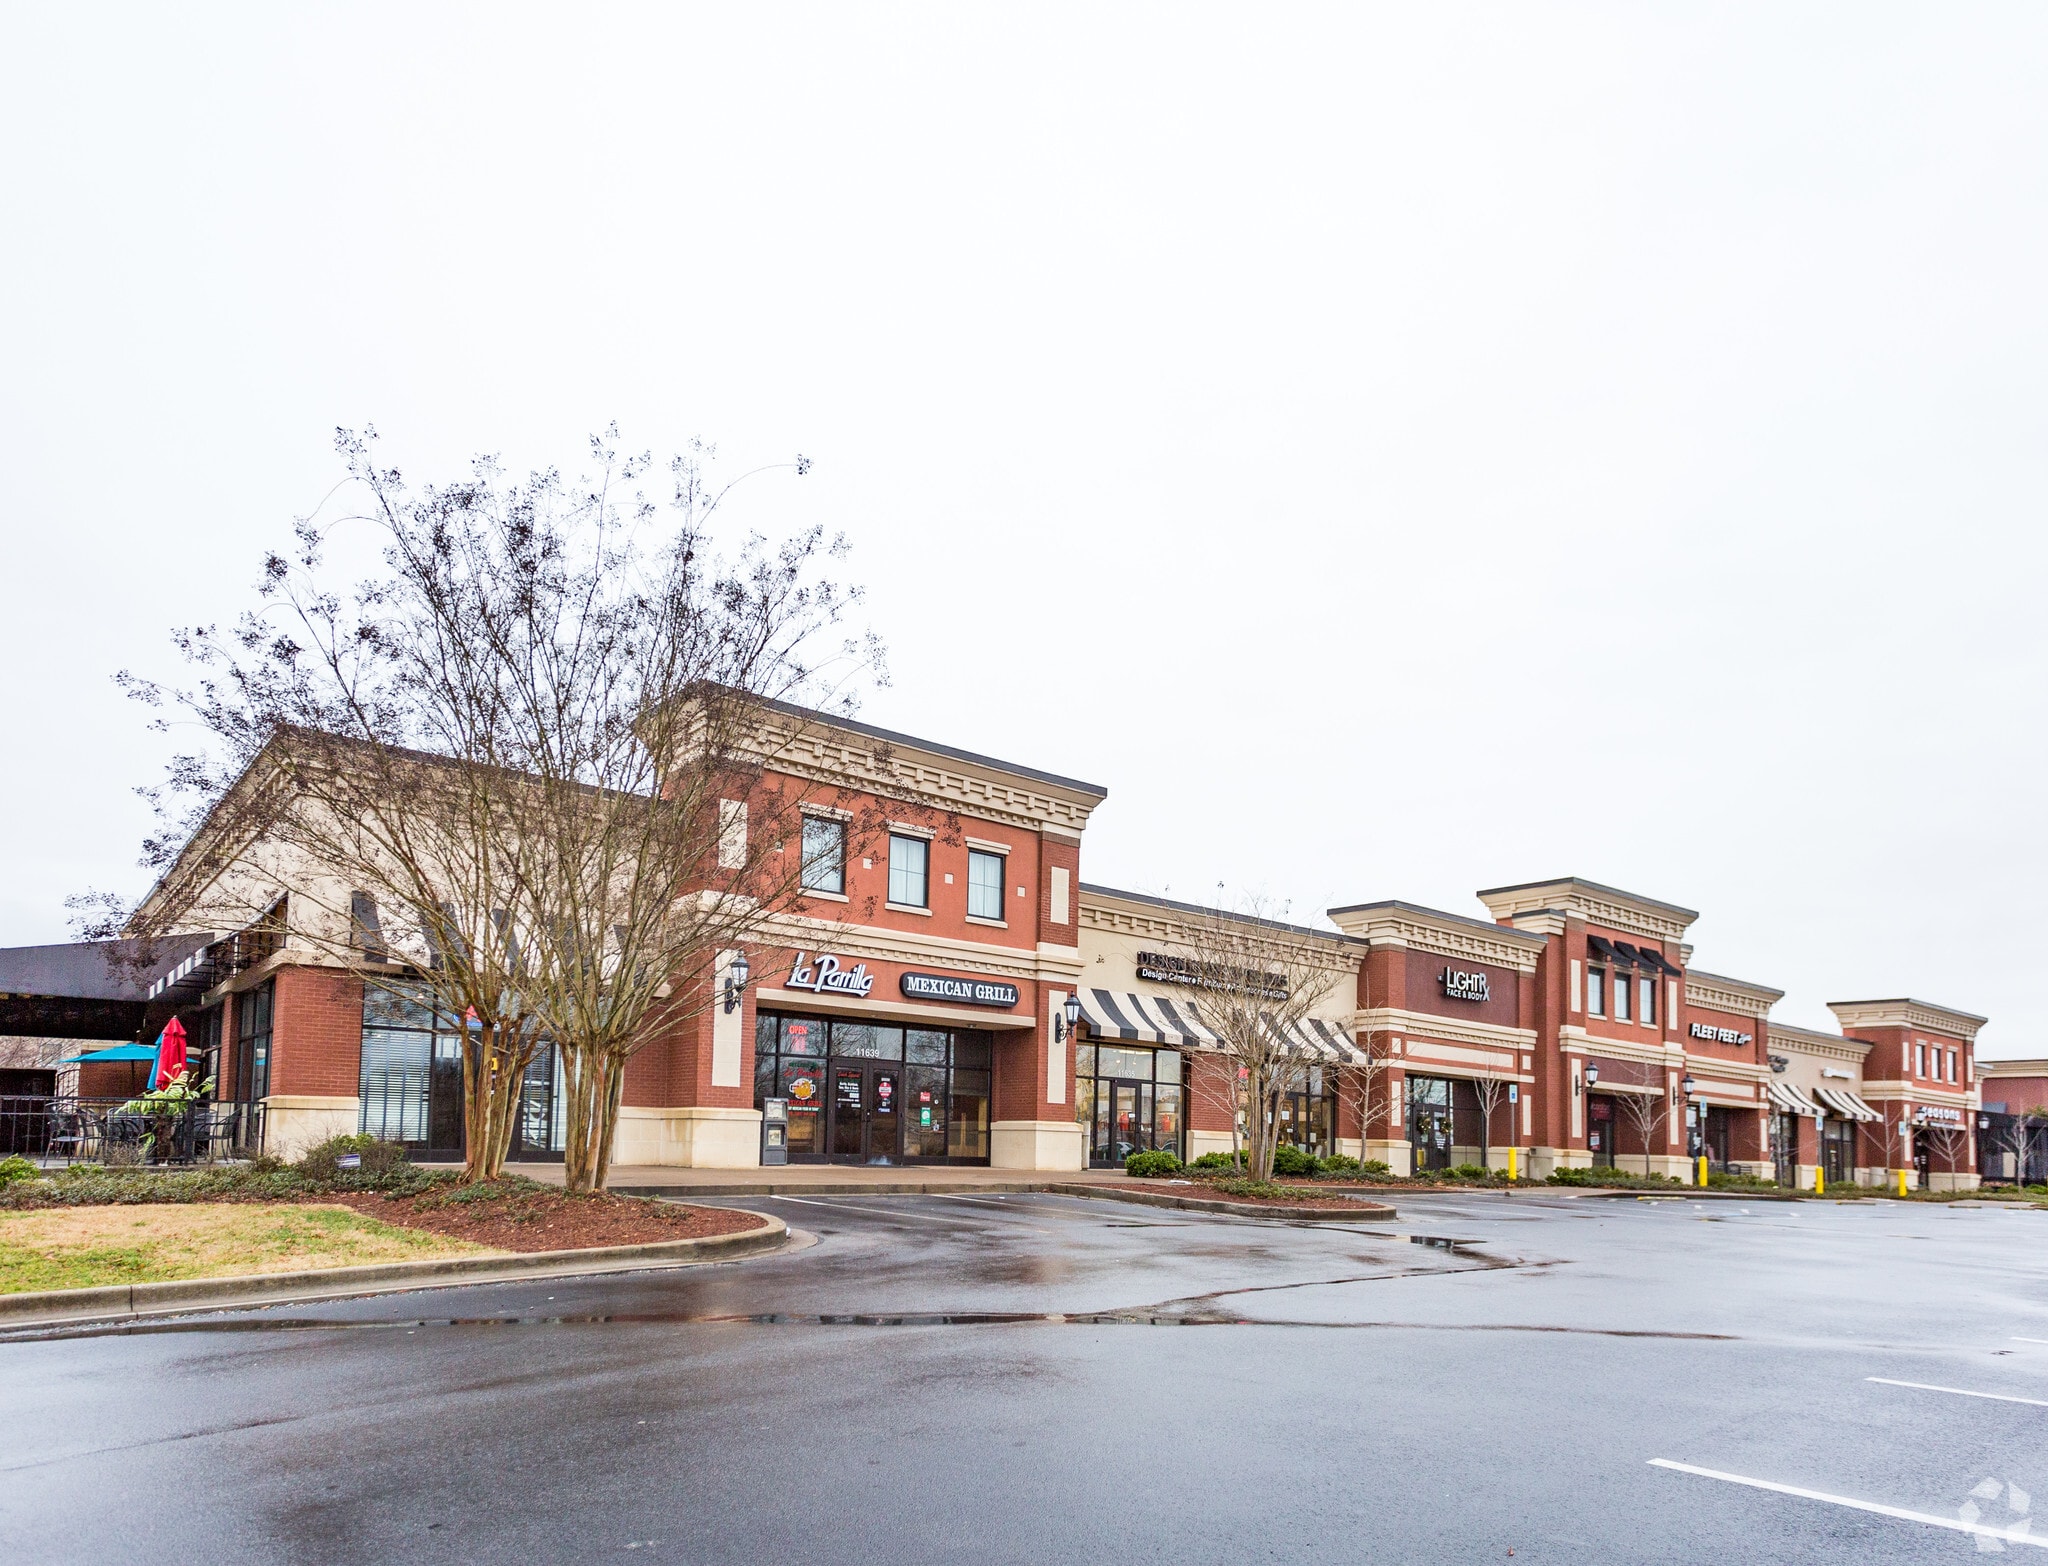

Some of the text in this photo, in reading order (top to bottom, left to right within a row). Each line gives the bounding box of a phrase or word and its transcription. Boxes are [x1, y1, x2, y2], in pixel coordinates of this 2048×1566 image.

[786, 951, 874, 997] La Parrilla
[1142, 968, 1167, 981] Design
[906, 976, 1016, 1003] MEXICAN GRILL
[1446, 988, 1462, 998] FACE
[1468, 991, 1483, 1001] BODY
[788, 1025, 808, 1035] OPEN
[1691, 1022, 1718, 1040] FLEET
[1717, 1027, 1739, 1044] FEET
[856, 1048, 880, 1058] 11639
